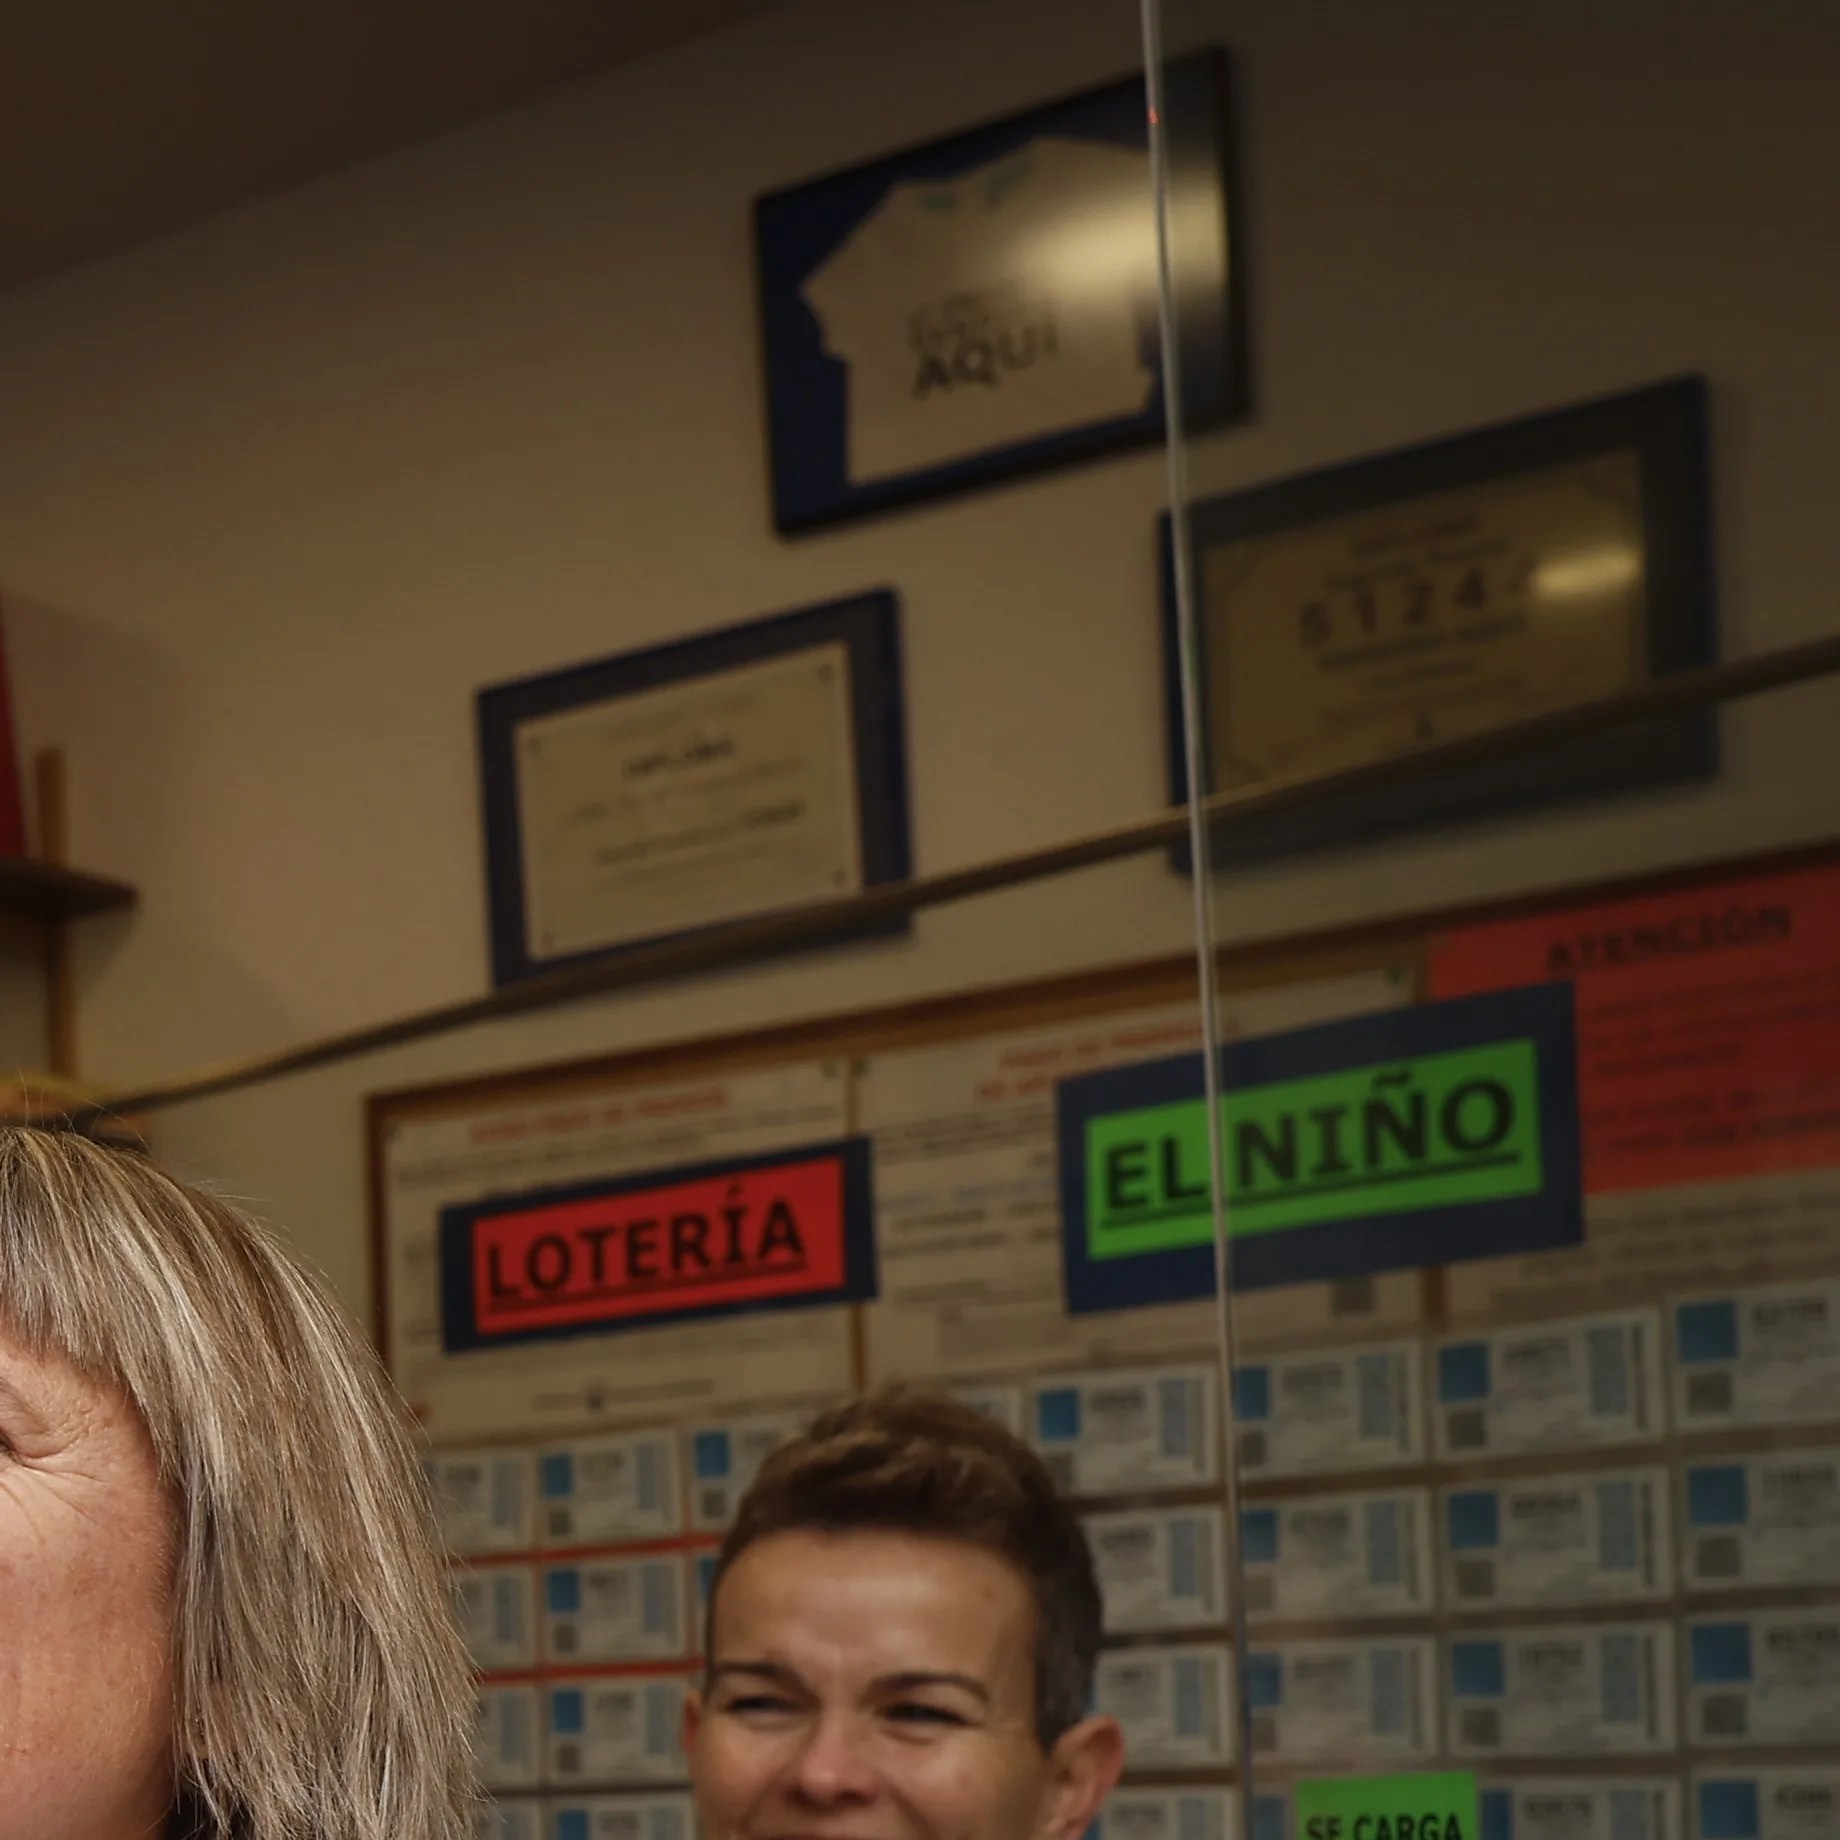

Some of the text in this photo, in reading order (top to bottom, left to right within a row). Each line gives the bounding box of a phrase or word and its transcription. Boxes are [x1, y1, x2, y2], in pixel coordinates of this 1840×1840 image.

[1100, 1135, 1208, 1211] EL
[1234, 1070, 1516, 1188] NIÑO
[484, 1186, 805, 1298] LOTERÍA
